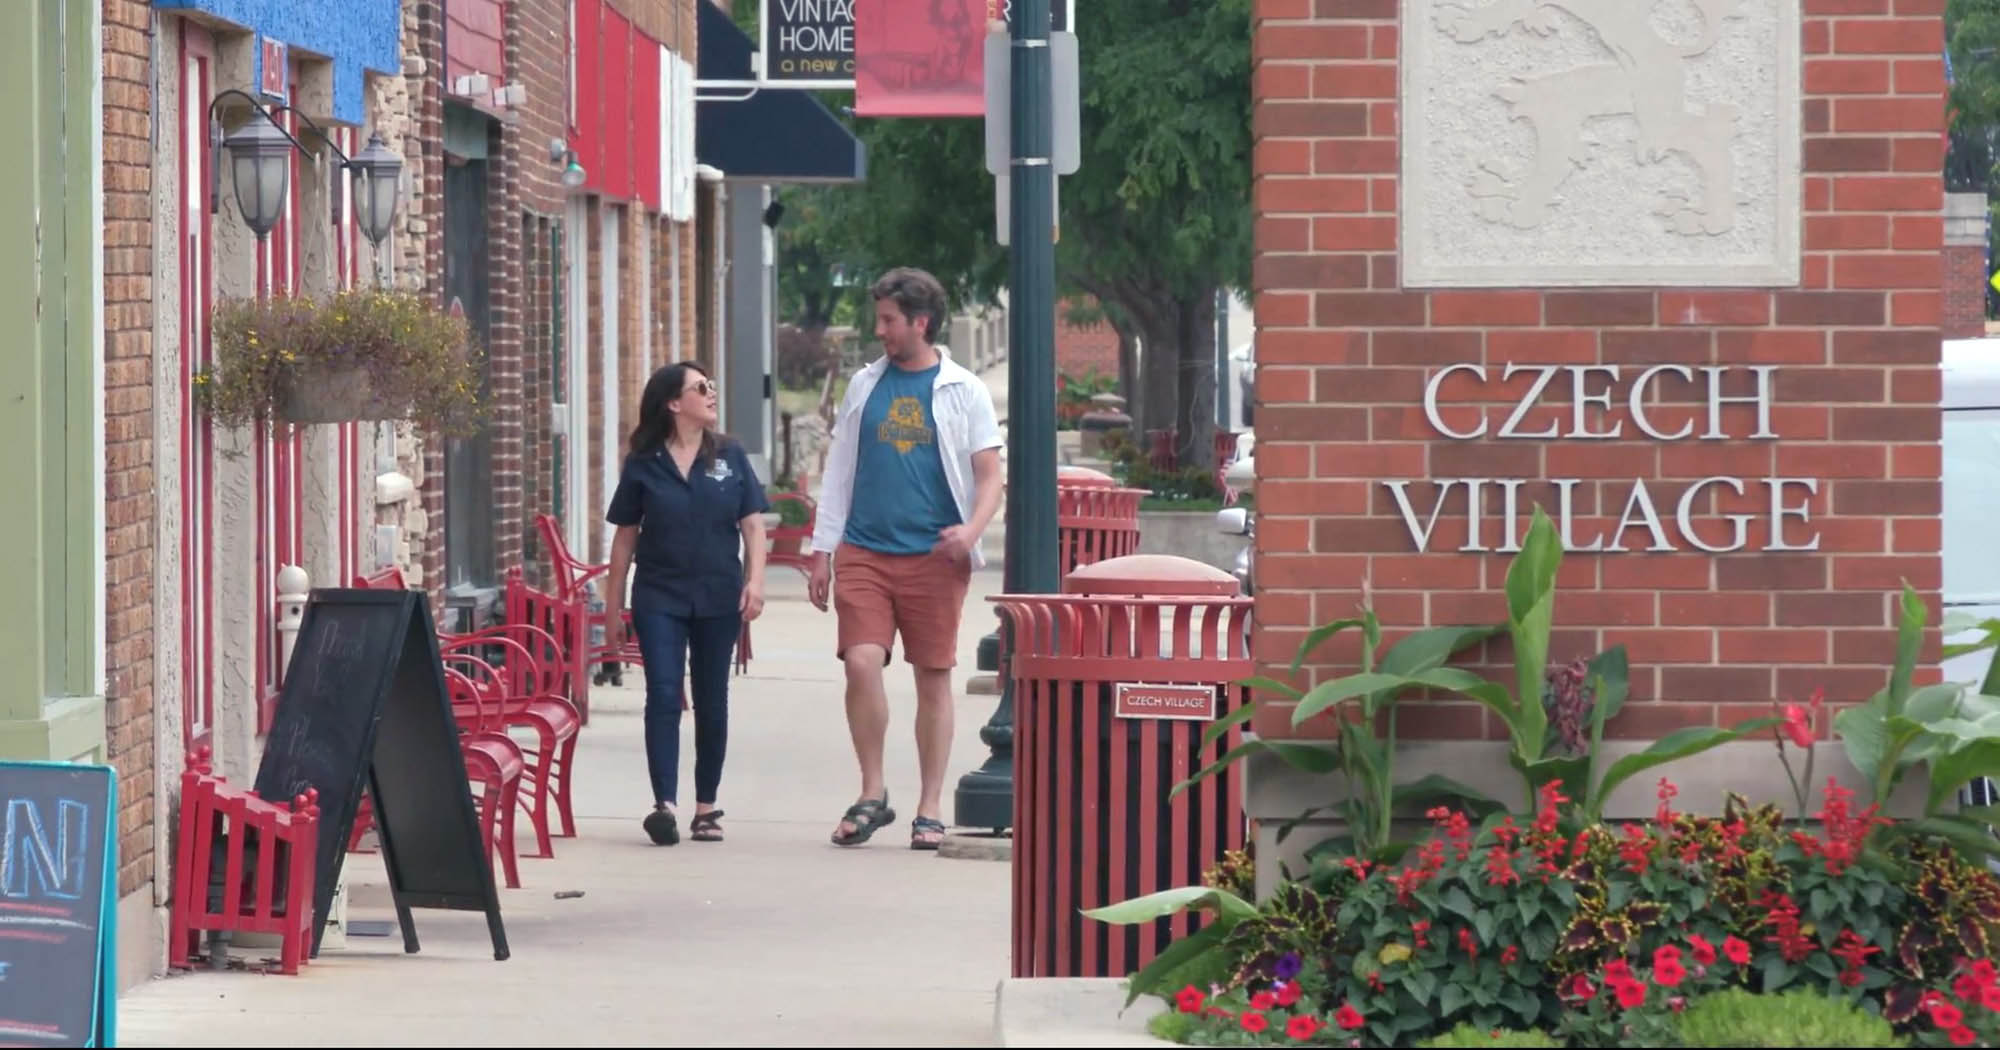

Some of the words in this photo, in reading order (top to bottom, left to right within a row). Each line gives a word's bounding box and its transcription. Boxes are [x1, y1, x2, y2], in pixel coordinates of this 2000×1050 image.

[780, 26, 855, 52] HOME
[781, 59, 794, 72] a
[800, 59, 836, 72] new
[1424, 361, 1780, 440] CZECH
[1382, 476, 1821, 553] VILLAGE
[1127, 696, 1162, 707] CZECH
[1164, 696, 1206, 709] VILLAGE
